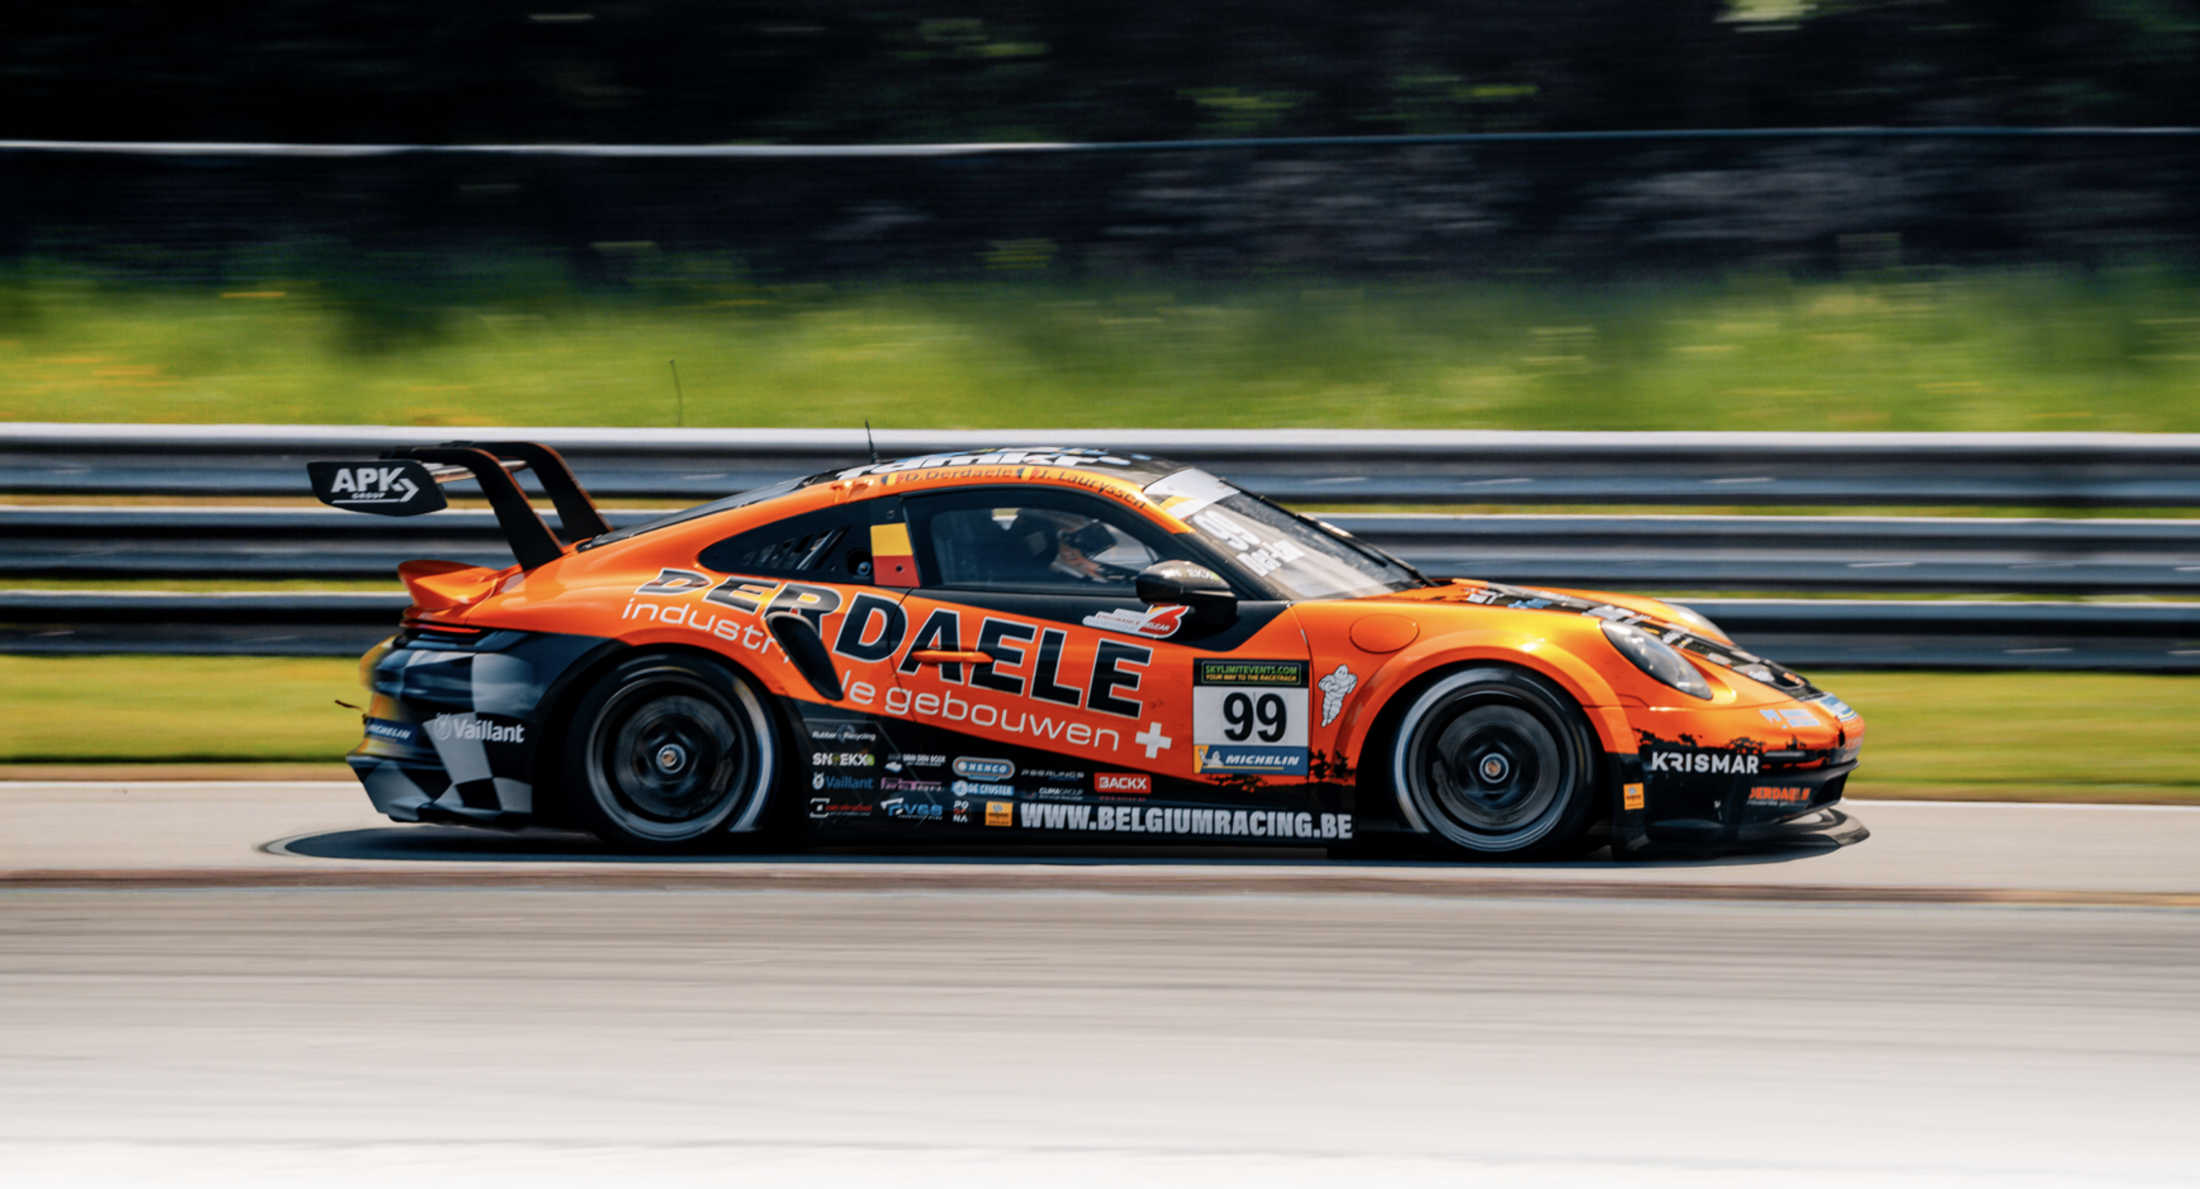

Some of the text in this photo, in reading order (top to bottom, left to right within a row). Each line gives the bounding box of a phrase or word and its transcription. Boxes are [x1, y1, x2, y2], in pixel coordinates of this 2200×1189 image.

[330, 467, 405, 493] APK
[1192, 510, 1261, 551] 99
[634, 567, 1153, 718] DERDAELE
[1205, 665, 1298, 675] SKYLIMITEVENTS.COM
[1260, 674, 1297, 682] RACETRACK
[885, 686, 1119, 751] gebouwen
[1223, 692, 1287, 743] 99
[452, 718, 525, 743] Vaillant
[1225, 755, 1300, 766] MICHELIN
[1651, 751, 1759, 774] KRISMAR
[826, 775, 875, 790] Vaillant
[1098, 776, 1147, 790] BACKX
[1020, 803, 1353, 839] WWW.BELGIUMRACING.BE
